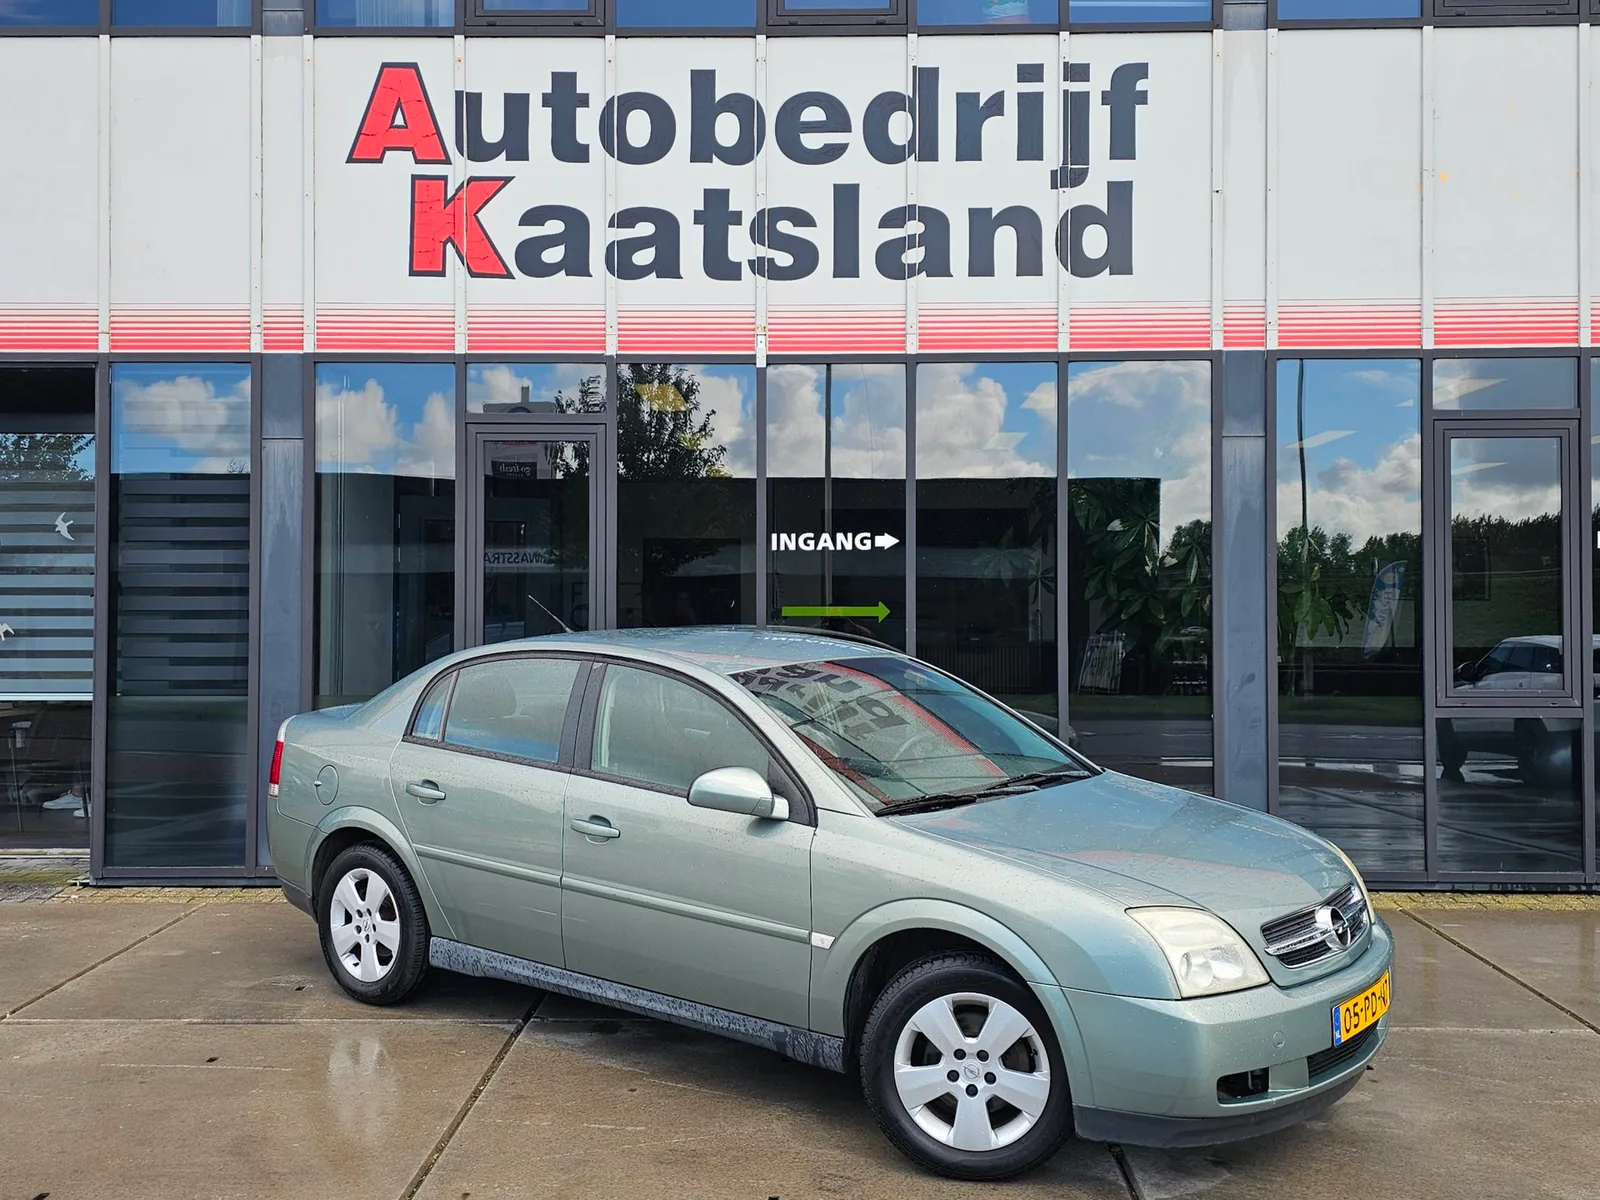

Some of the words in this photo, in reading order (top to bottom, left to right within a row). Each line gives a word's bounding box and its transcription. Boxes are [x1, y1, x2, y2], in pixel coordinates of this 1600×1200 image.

[346, 61, 1150, 190] Autobedrijf
[408, 175, 1135, 281] Kaatsland
[771, 532, 872, 551] INGANG
